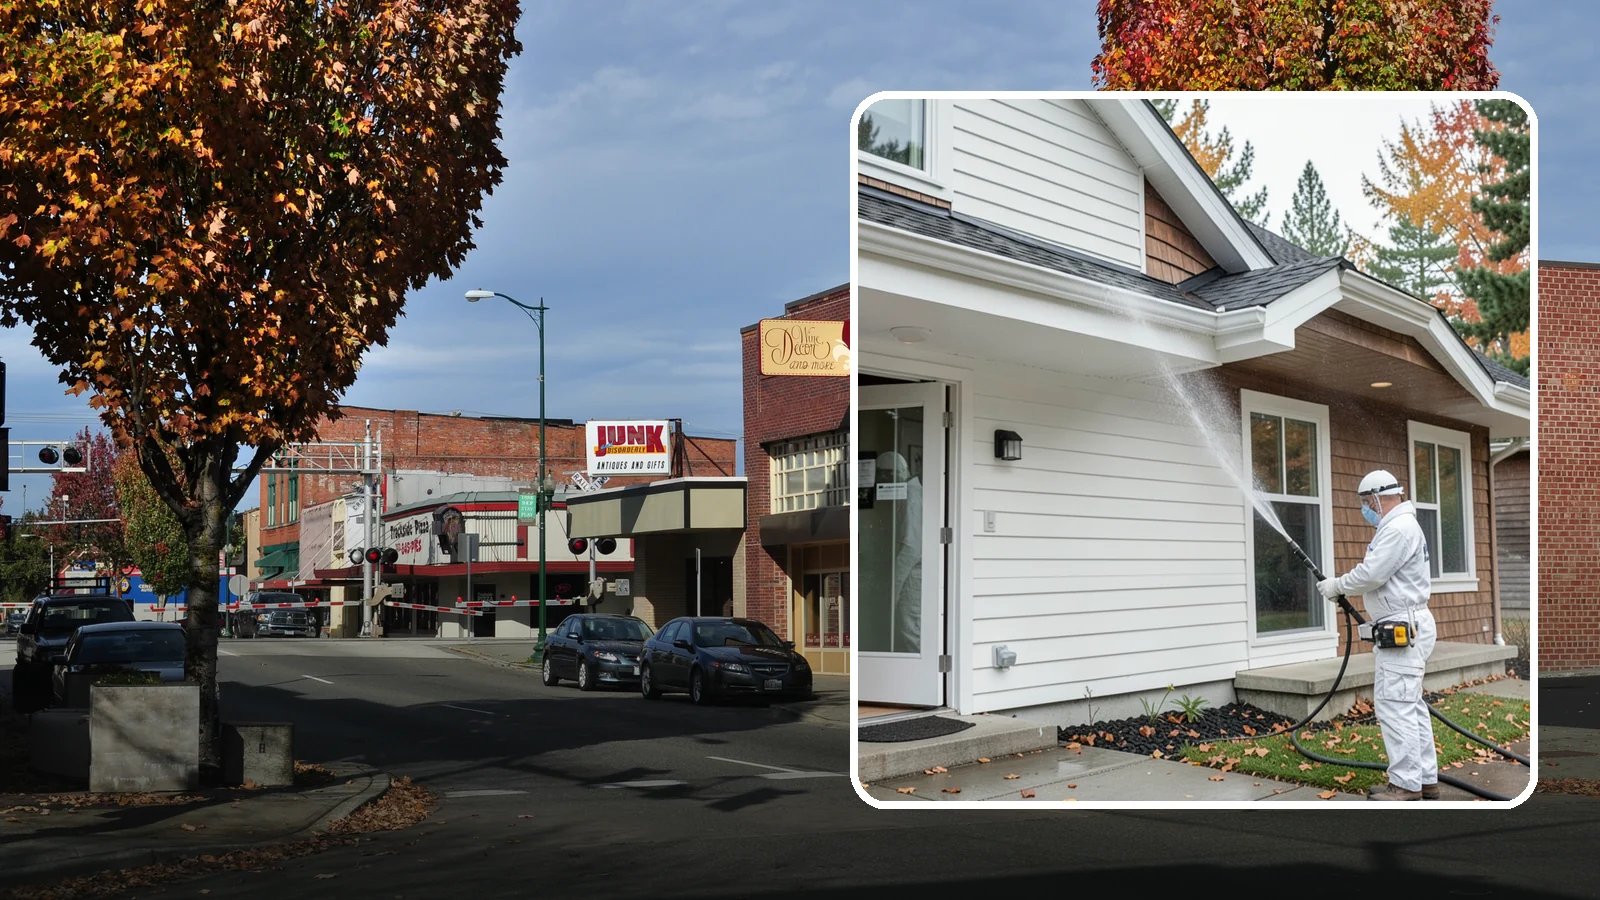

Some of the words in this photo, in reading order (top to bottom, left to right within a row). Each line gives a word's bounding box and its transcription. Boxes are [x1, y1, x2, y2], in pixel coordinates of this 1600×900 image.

[765, 327, 831, 365] Decor
[595, 425, 665, 457] JUNK
[607, 446, 646, 454] DISORDERLY
[597, 461, 628, 470] ANTIQUES
[631, 461, 644, 470] AND
[647, 460, 665, 469] GIFTS
[390, 521, 413, 539] Trackside
[414, 519, 429, 535] Pizza
